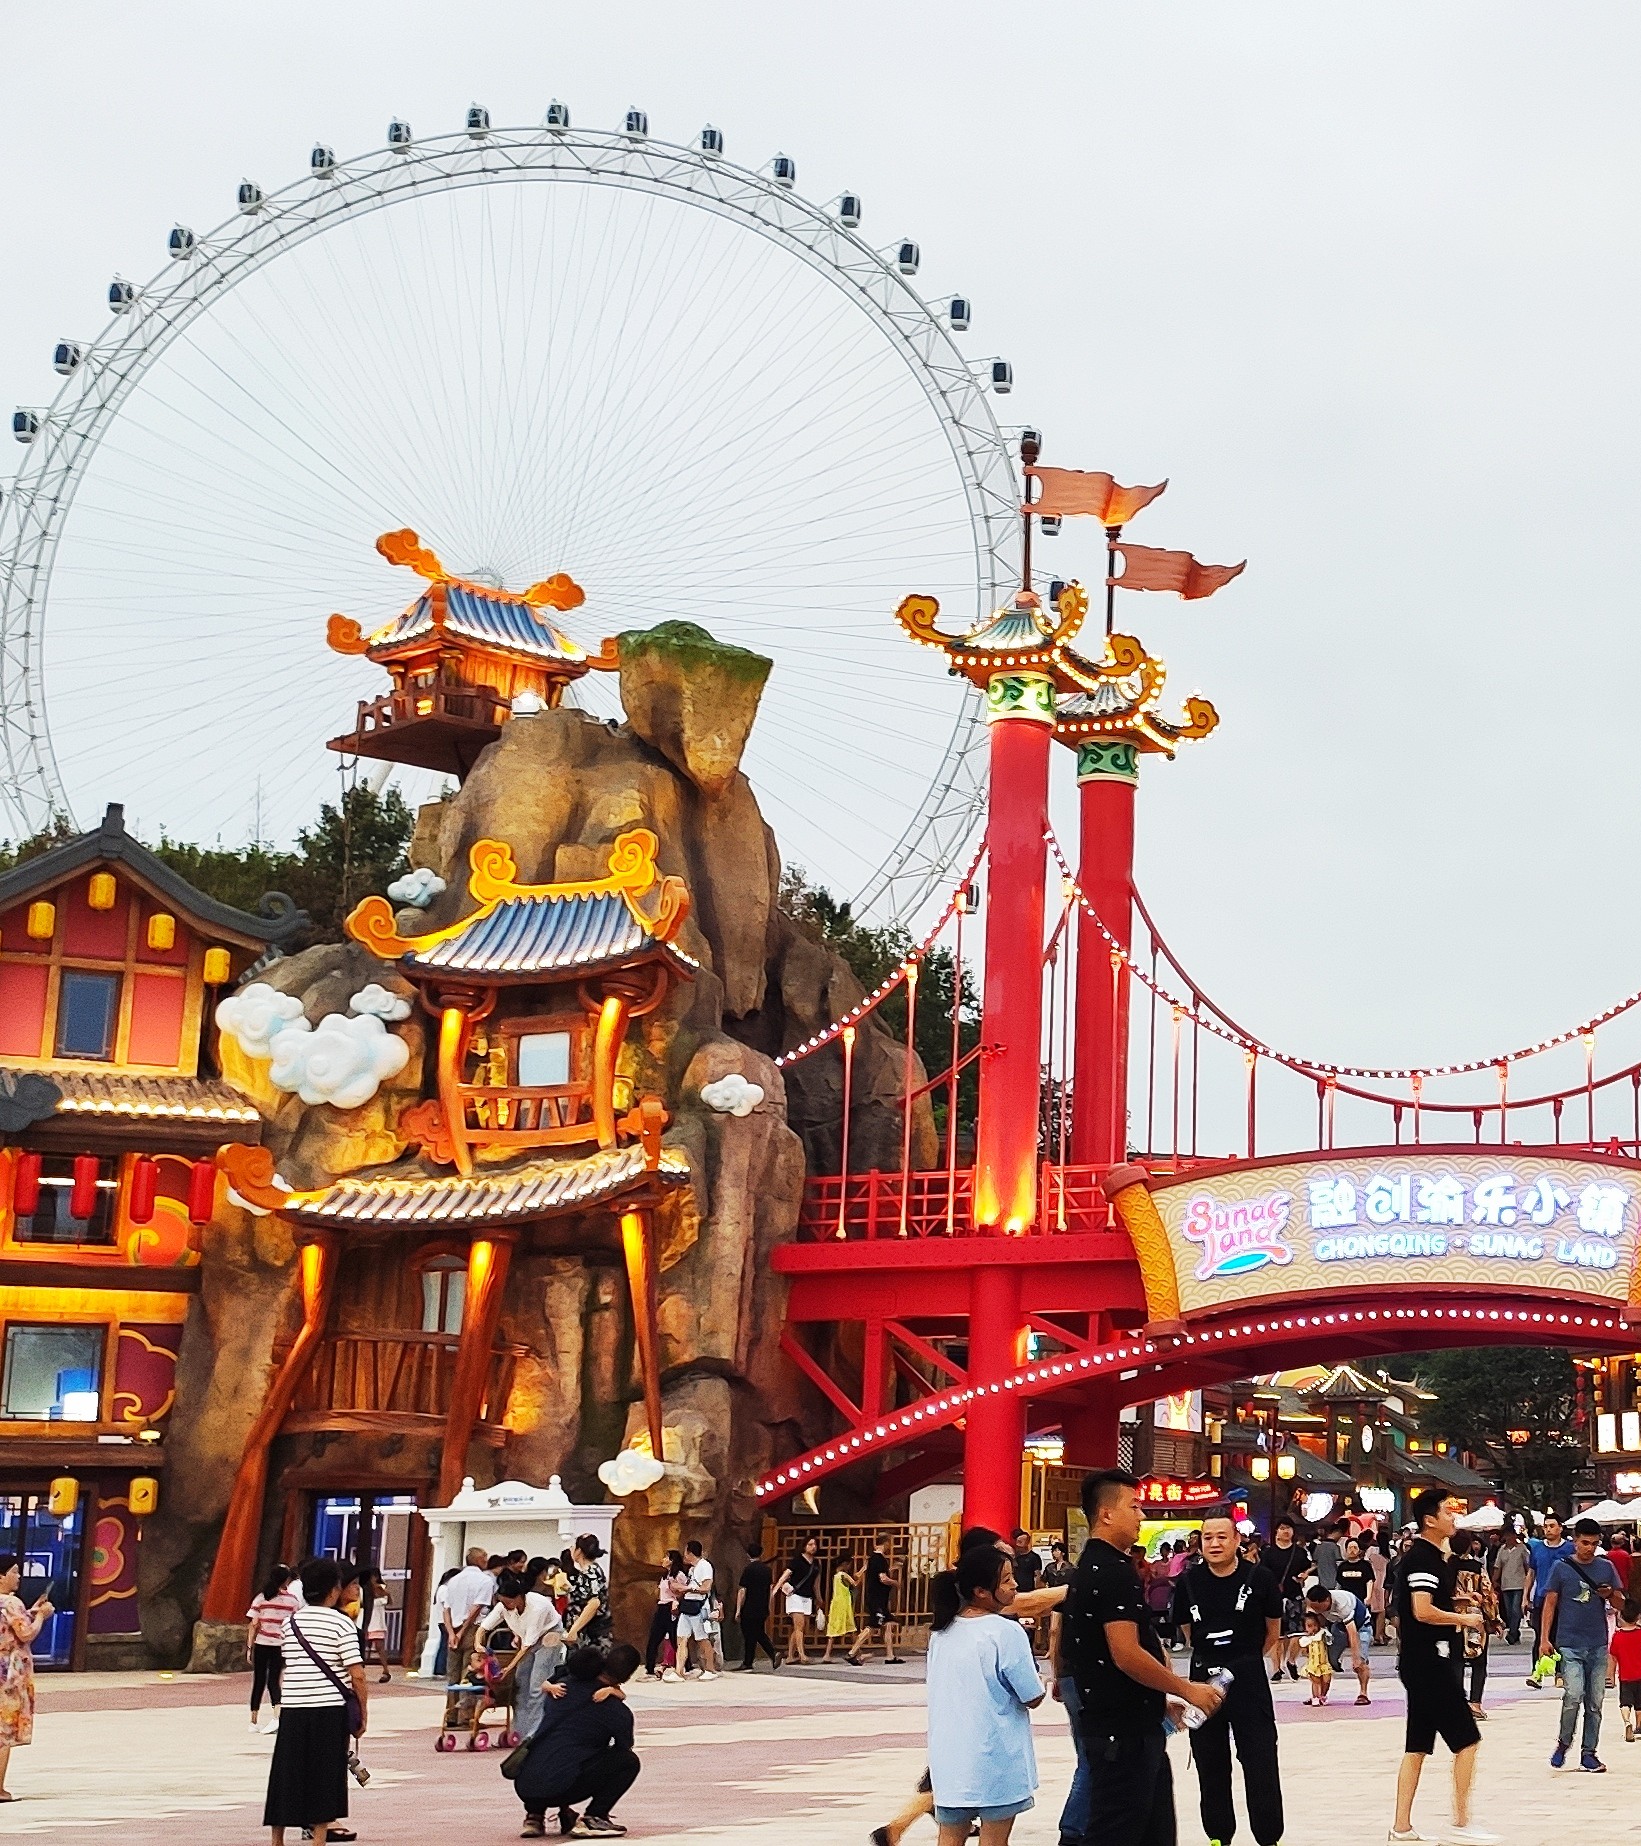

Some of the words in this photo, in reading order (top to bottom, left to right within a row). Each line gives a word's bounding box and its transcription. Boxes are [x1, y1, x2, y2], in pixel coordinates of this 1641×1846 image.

[1185, 1193, 1291, 1236] Sunac
[1309, 1174, 1631, 1237] 融创渝乐小镇
[1199, 1221, 1288, 1276] Land
[1315, 1232, 1447, 1261] CHONGQING
[1469, 1233, 1543, 1260] SUNAC
[1556, 1239, 1618, 1269] LAND
